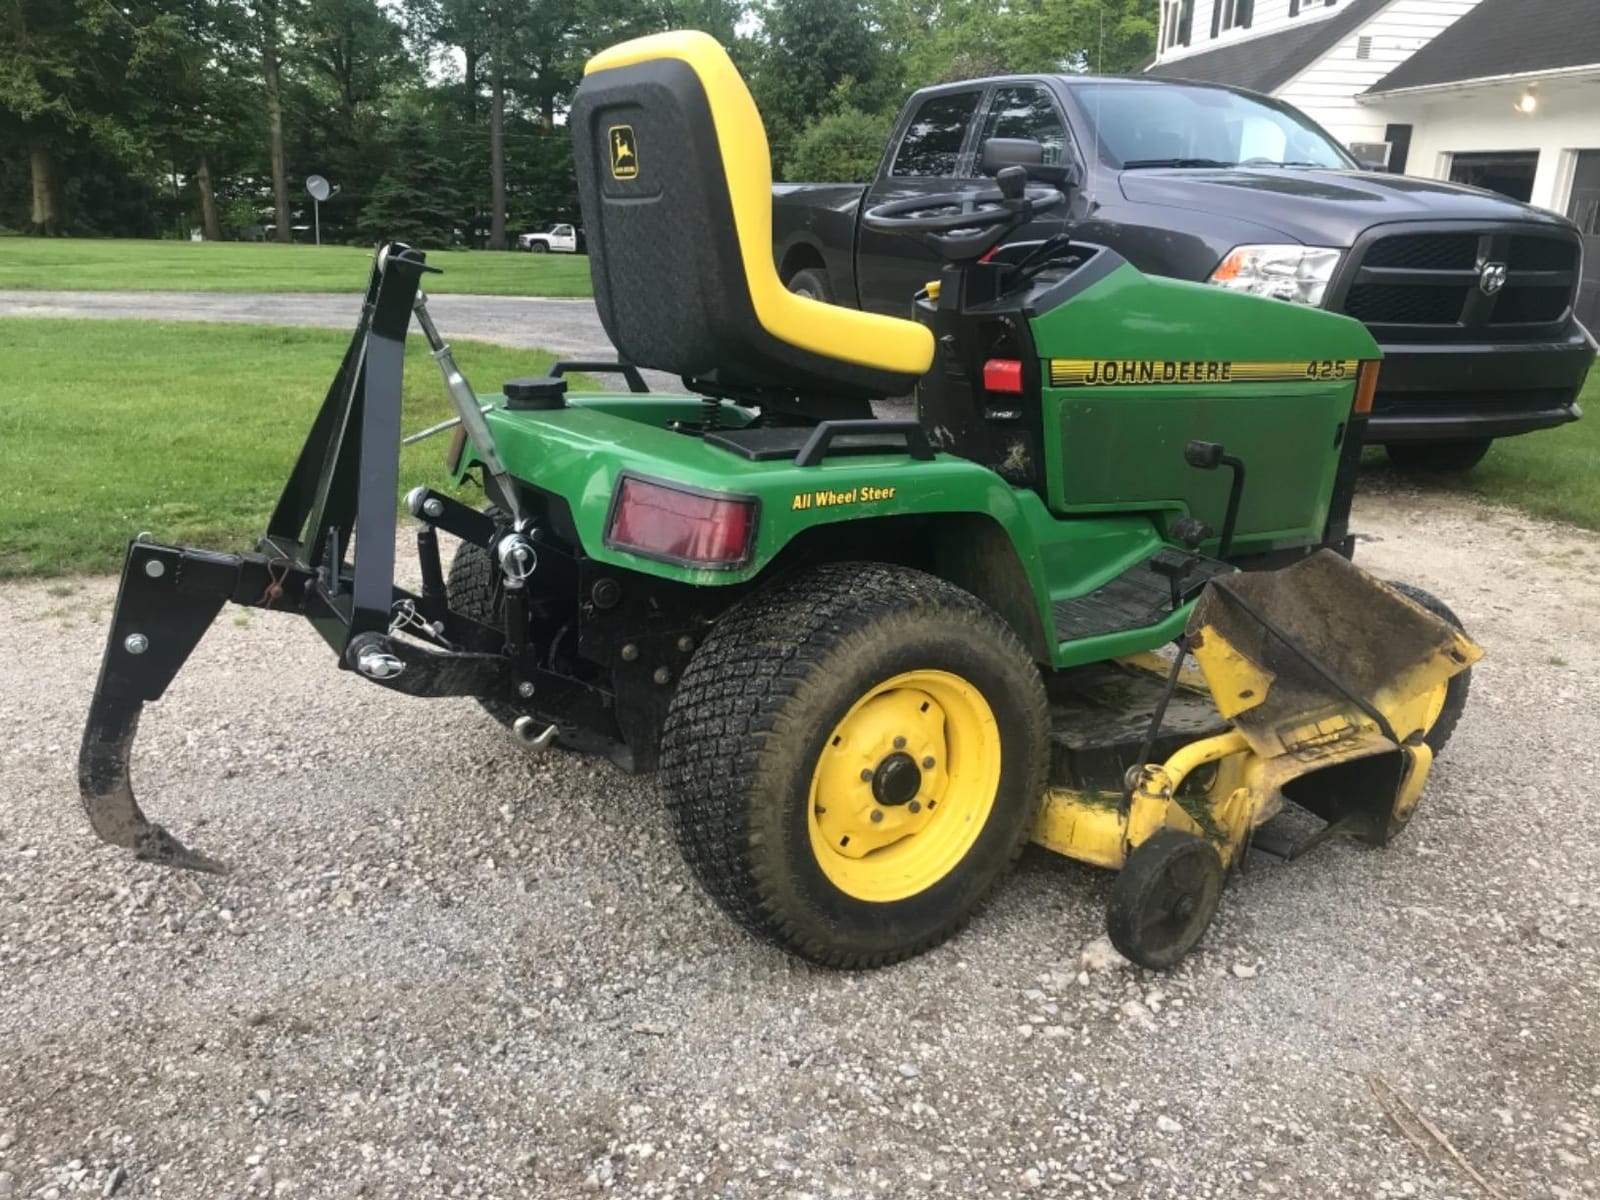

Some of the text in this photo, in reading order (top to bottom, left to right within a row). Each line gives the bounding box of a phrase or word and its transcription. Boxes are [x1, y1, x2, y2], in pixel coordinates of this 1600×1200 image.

[1084, 360, 1346, 385] JOHN DEERE 425
[792, 486, 896, 511] All Wheel Steer
